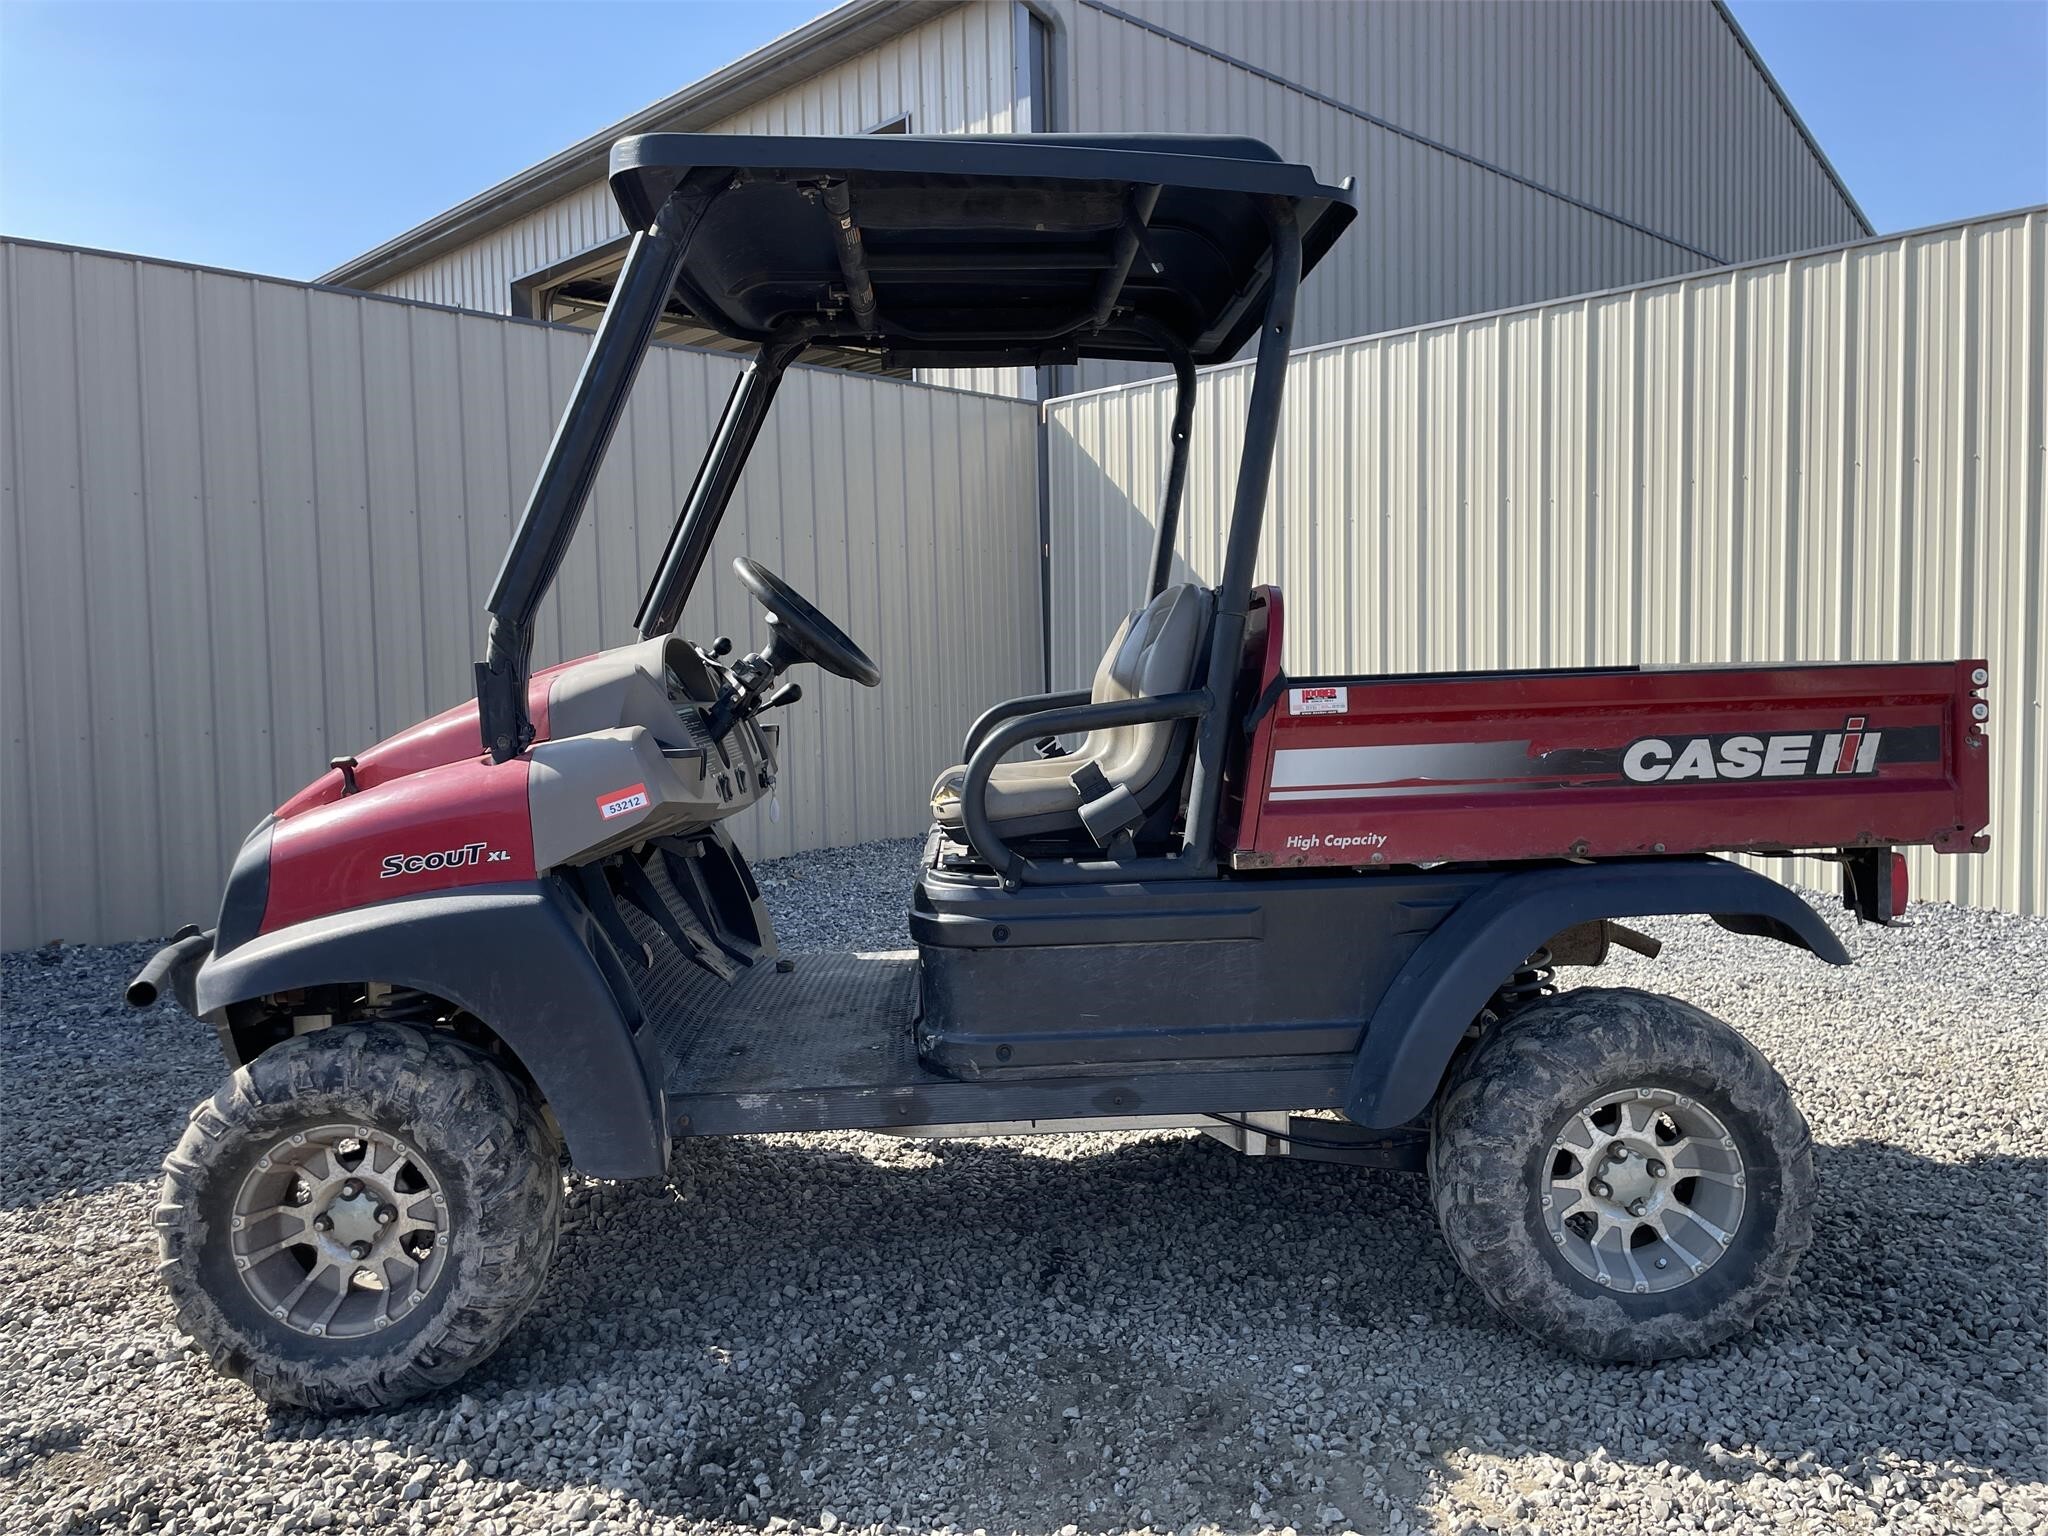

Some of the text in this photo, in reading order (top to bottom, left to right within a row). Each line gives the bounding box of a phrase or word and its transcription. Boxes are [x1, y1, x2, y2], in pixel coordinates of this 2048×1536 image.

[1623, 735, 1812, 782] CASE
[609, 796, 641, 814] 53212
[1286, 832, 1387, 851] High Capacity
[487, 850, 511, 862] XL
